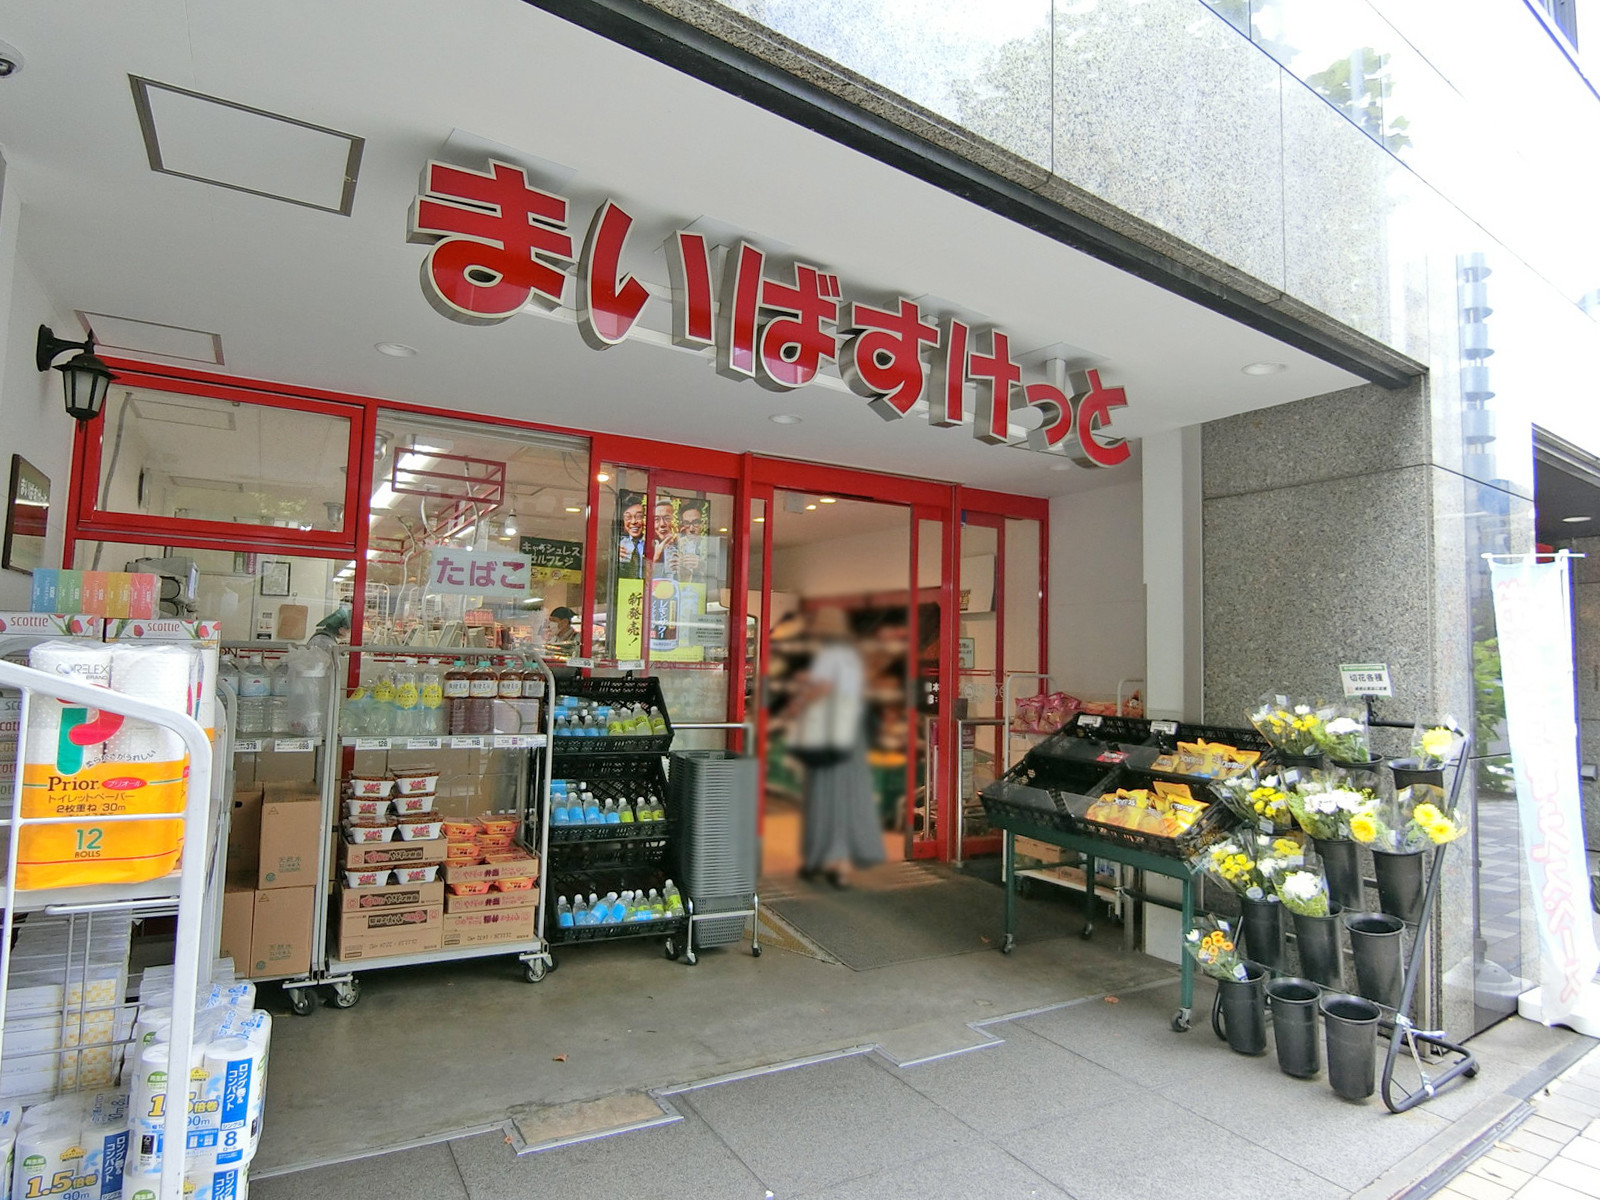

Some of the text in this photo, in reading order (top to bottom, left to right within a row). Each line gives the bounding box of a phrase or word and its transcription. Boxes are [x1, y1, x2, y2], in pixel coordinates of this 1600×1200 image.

[411, 157, 1131, 468] まいばすけっと
[521, 541, 580, 557] キャッシュレス
[436, 556, 526, 590] たばこ
[47, 775, 99, 792] Prior
[107, 780, 142, 788] プリオール
[48, 793, 135, 804] トイレットペーパー
[56, 802, 126, 813] 2枚重ね 30m
[76, 828, 103, 850] 12
[74, 850, 101, 858] ROLLS
[226, 1070, 238, 1111] コンパクト
[148, 1091, 220, 1117] 1倍巻
[224, 1131, 238, 1147] 8
[104, 1144, 115, 1183] コンパクト
[25, 1169, 98, 1198] 1.5倍巻
